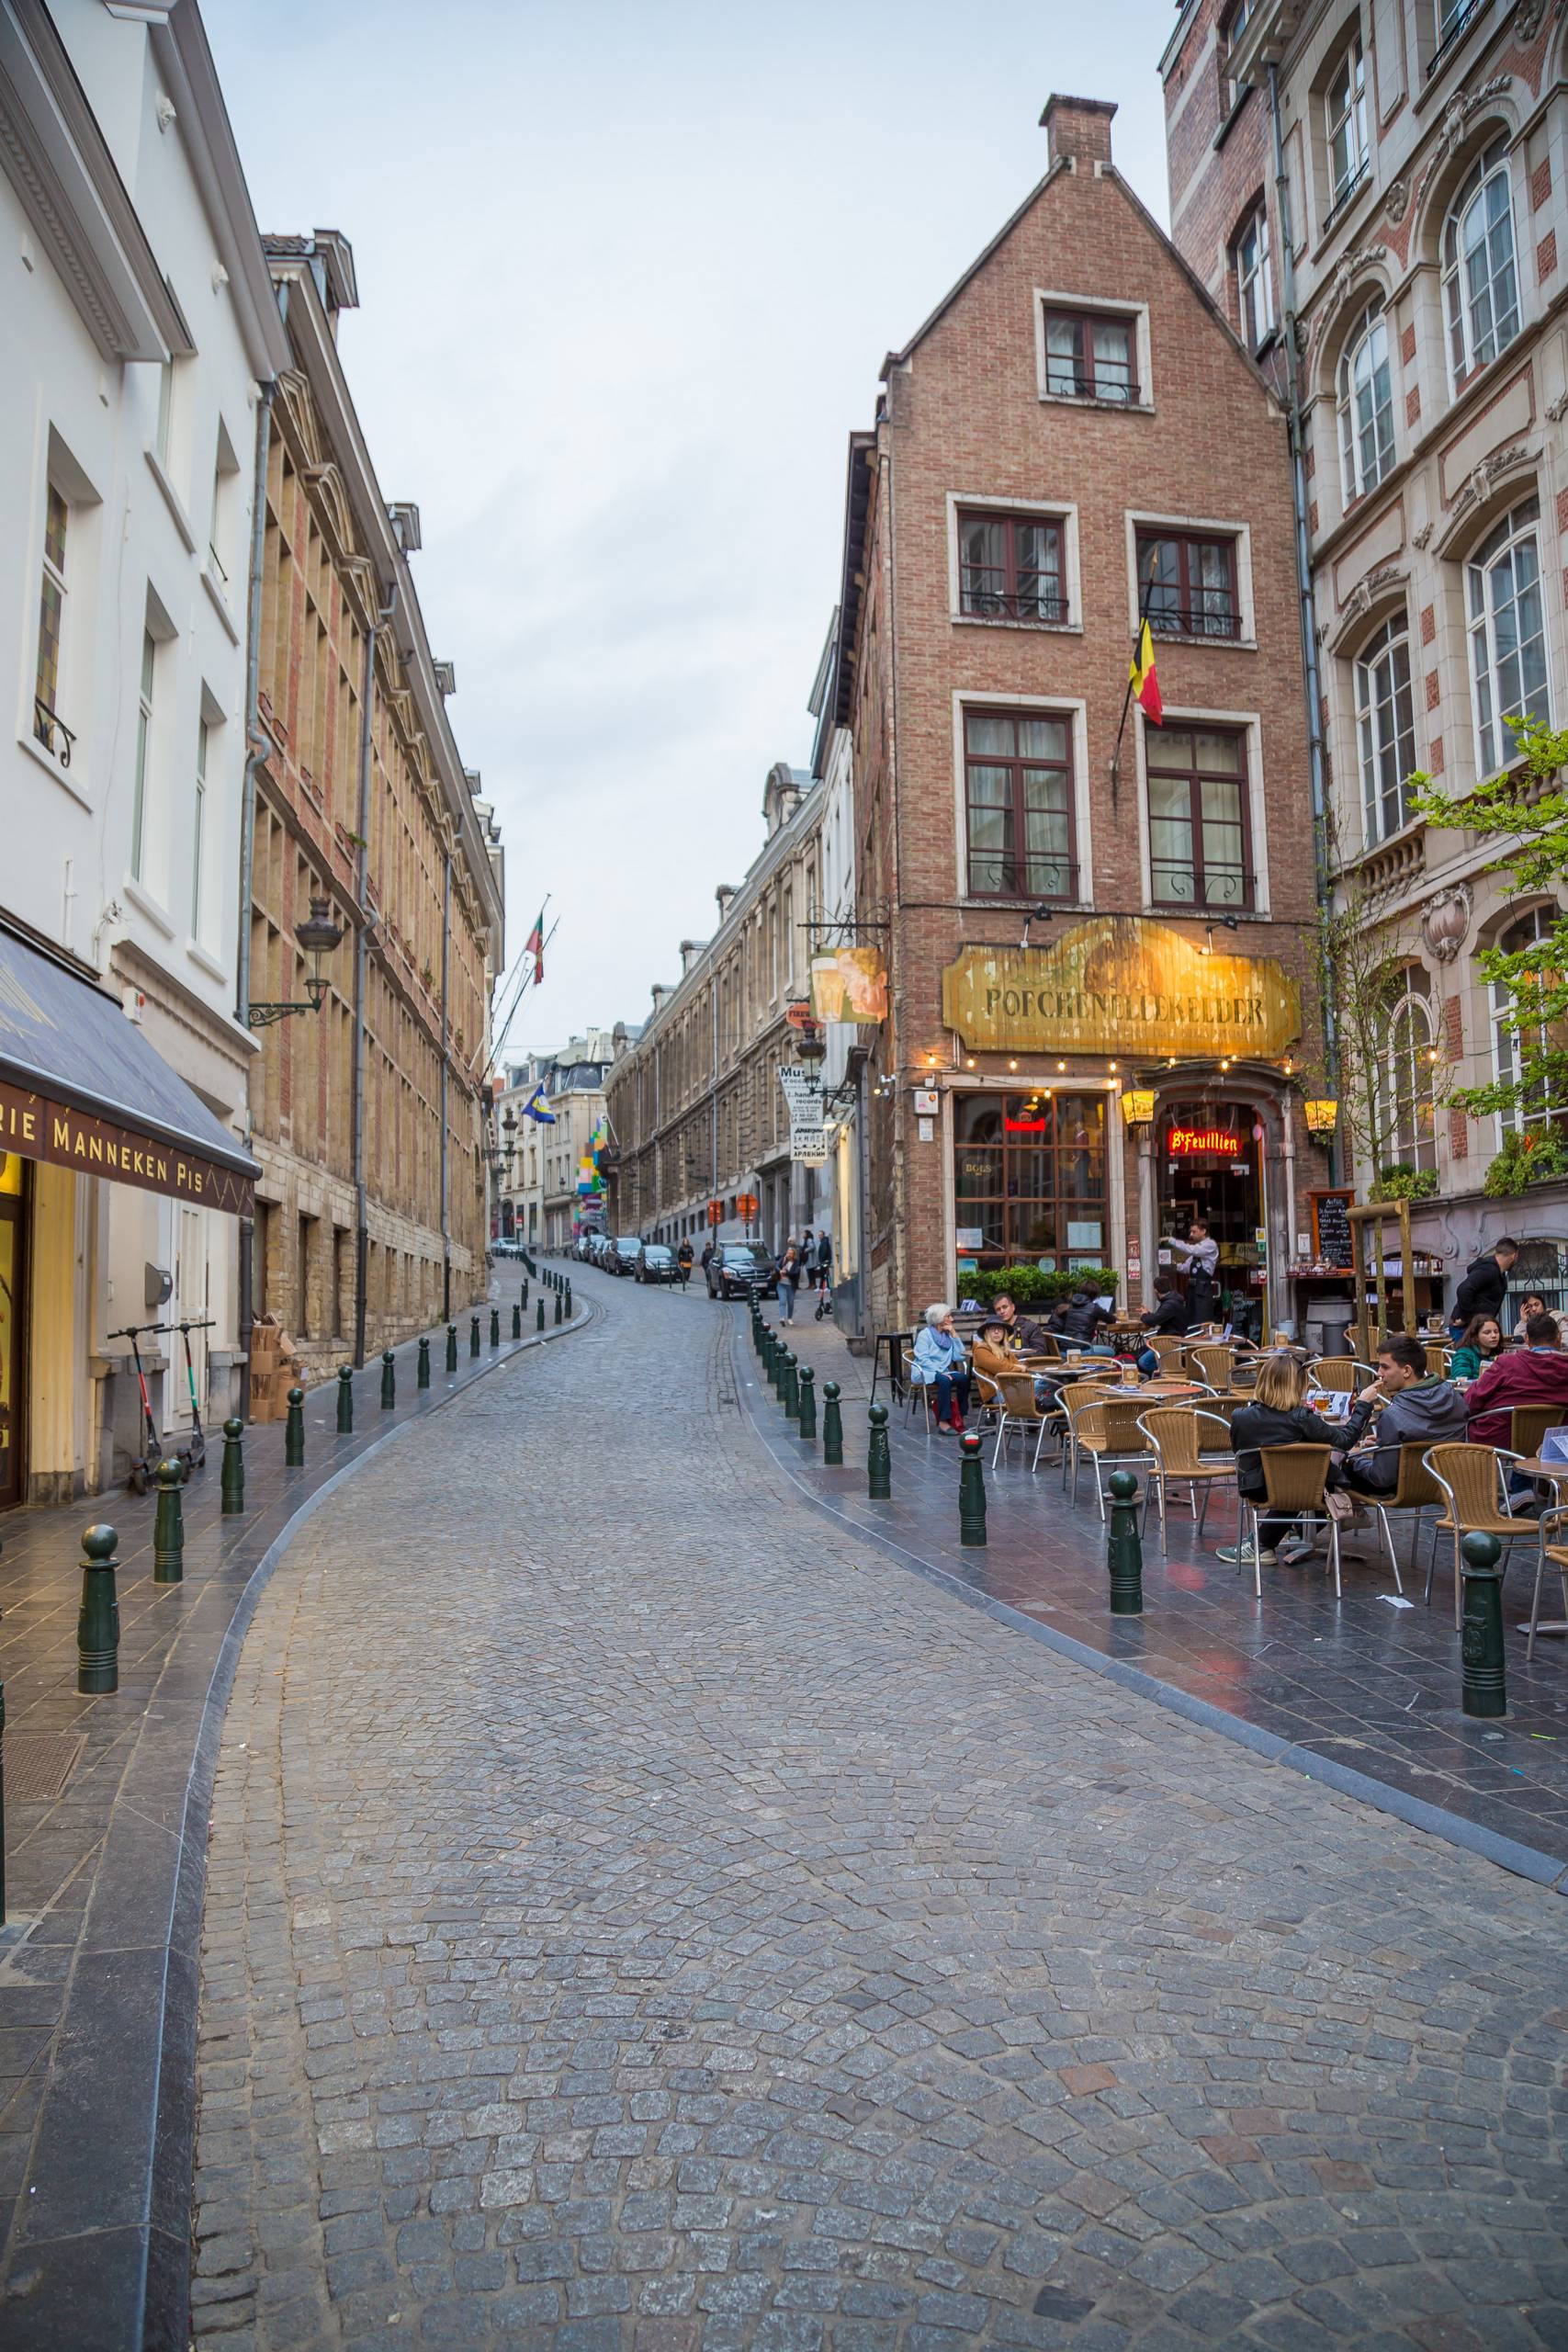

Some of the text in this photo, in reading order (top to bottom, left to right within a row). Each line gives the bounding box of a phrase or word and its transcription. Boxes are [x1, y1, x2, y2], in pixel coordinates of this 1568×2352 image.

[0, 1103, 202, 1193] IE MANNEKEN PIS
[965, 1163, 993, 1173] BOLS
